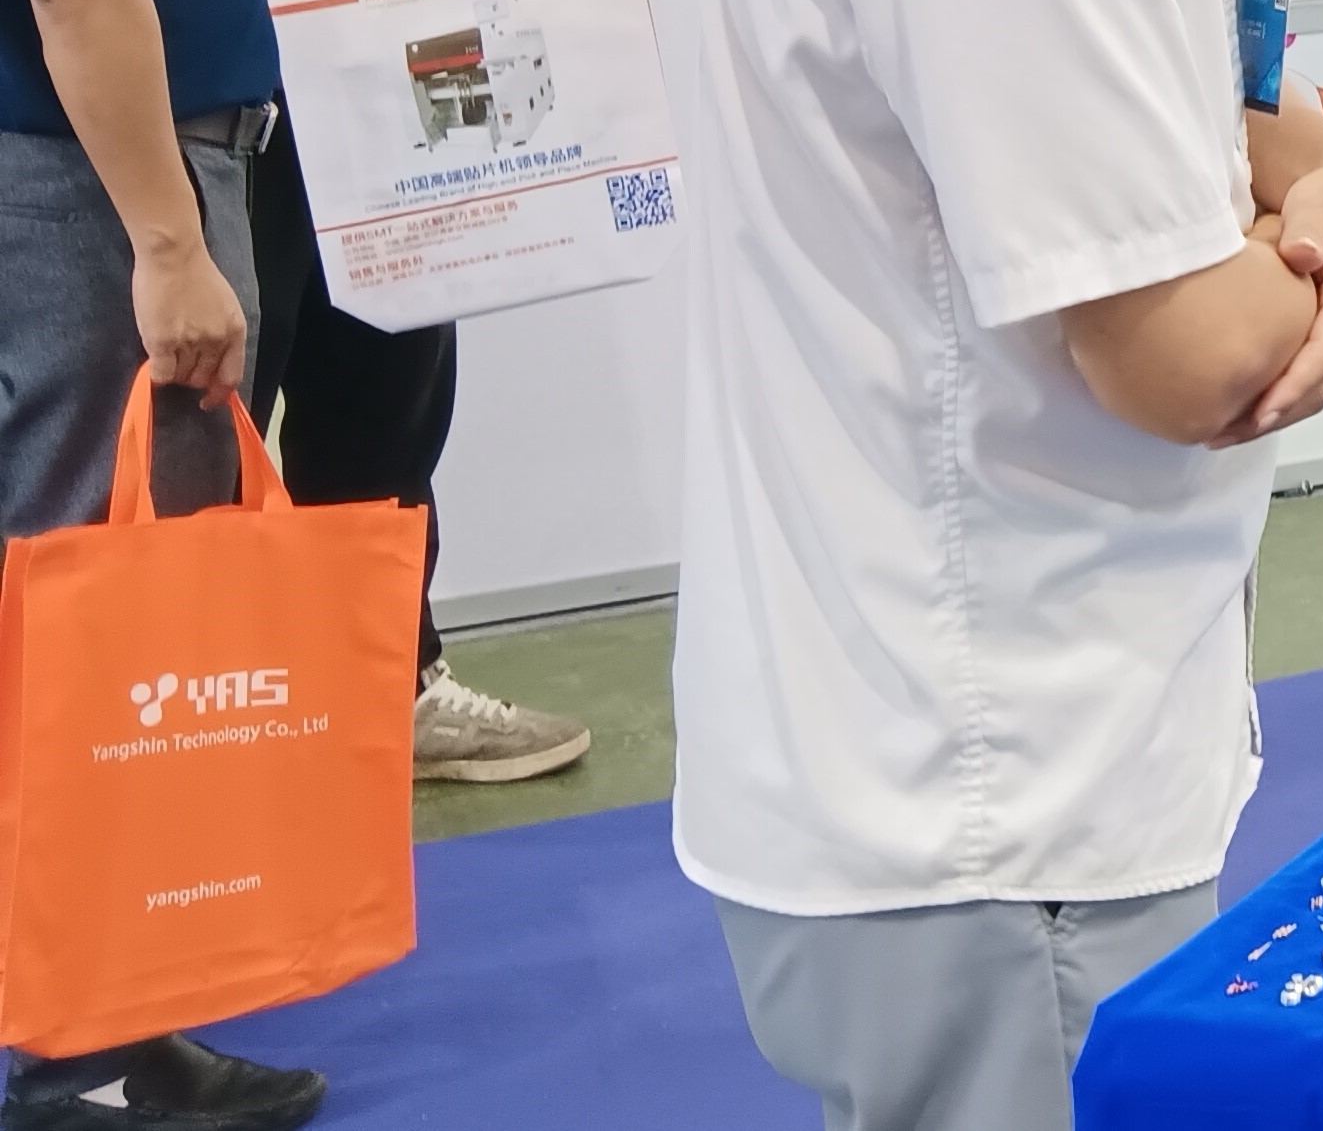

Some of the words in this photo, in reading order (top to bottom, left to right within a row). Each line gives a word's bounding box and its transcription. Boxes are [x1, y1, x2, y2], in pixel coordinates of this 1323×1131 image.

[187, 668, 289, 714] YAS
[92, 736, 168, 762] Yangshin
[172, 722, 260, 752] Technology
[264, 719, 298, 738] Co.,
[303, 713, 329, 734] Ltd
[146, 874, 262, 912] yangshin.com
